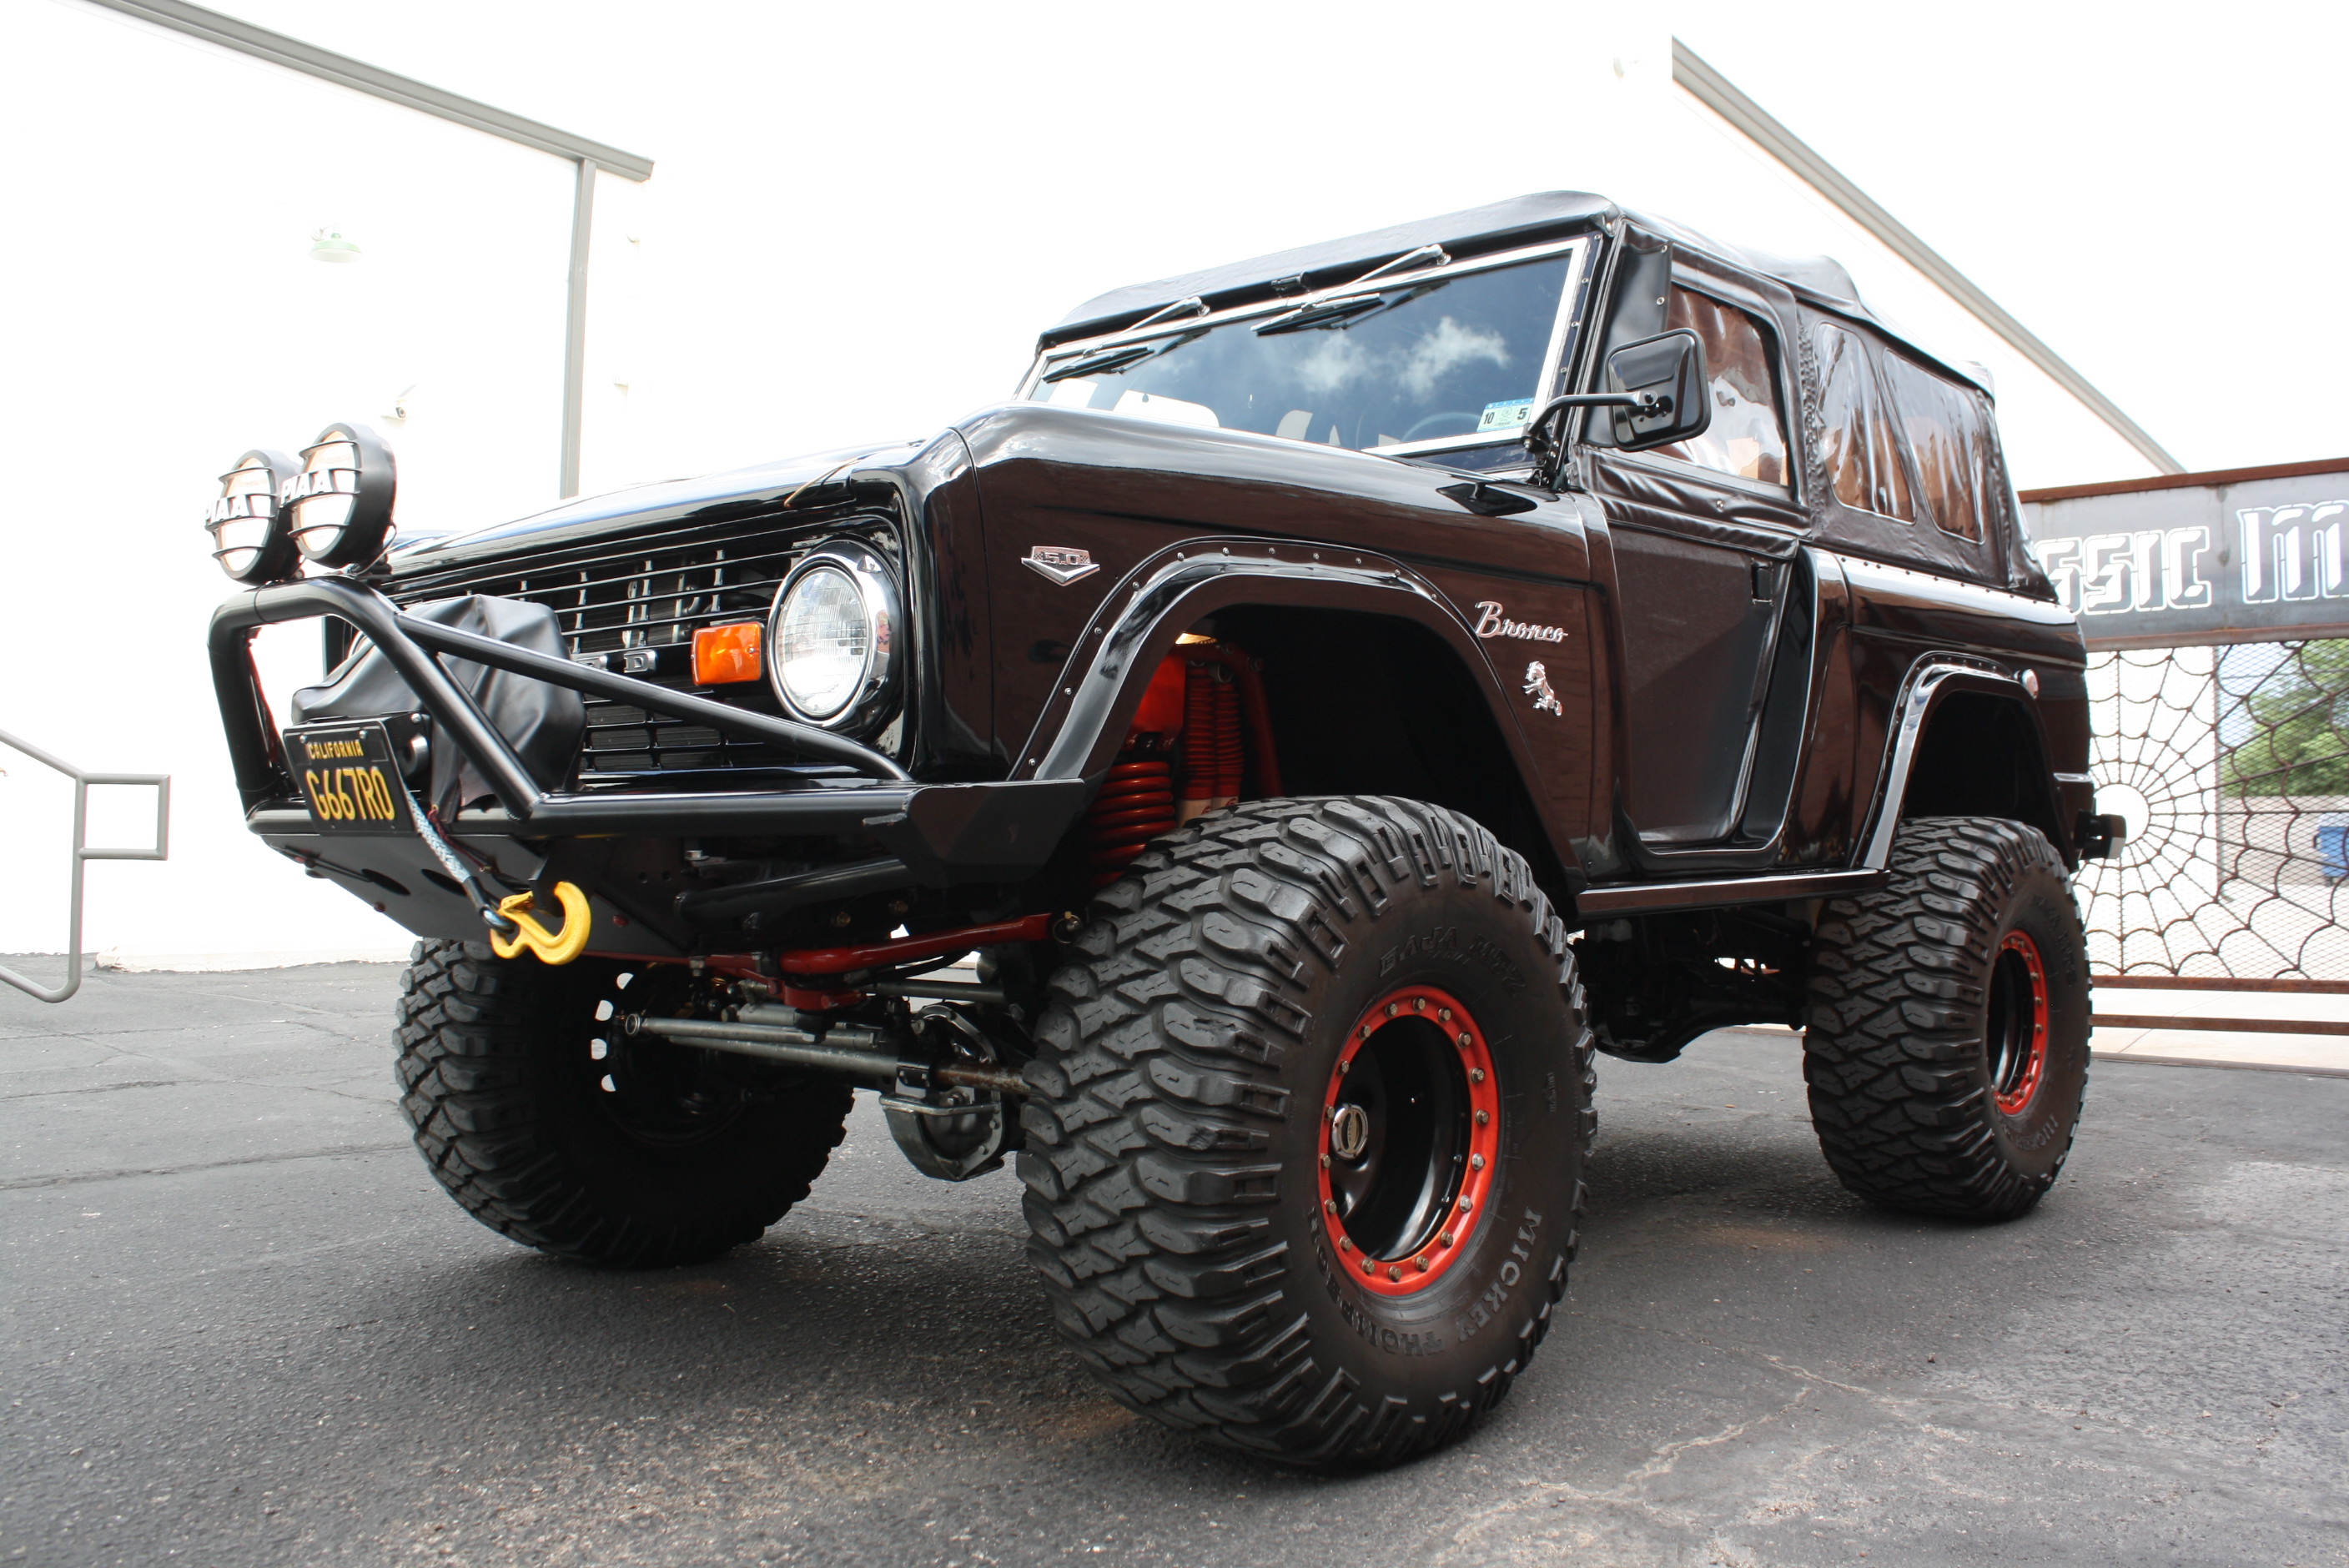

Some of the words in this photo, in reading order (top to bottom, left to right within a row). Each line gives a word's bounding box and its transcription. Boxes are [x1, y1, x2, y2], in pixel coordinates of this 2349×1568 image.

[1482, 411, 1496, 425] 10
[1517, 407, 1529, 420] 5
[280, 469, 333, 505] PIAA
[204, 494, 249, 523] PIAA
[1043, 551, 1081, 565] 5.0
[1475, 601, 1568, 643] Bronco
[306, 739, 365, 760] CALIFORNIA
[1307, 1206, 1445, 1357] THOMPSON
[1455, 1205, 1543, 1343] MICKEY
